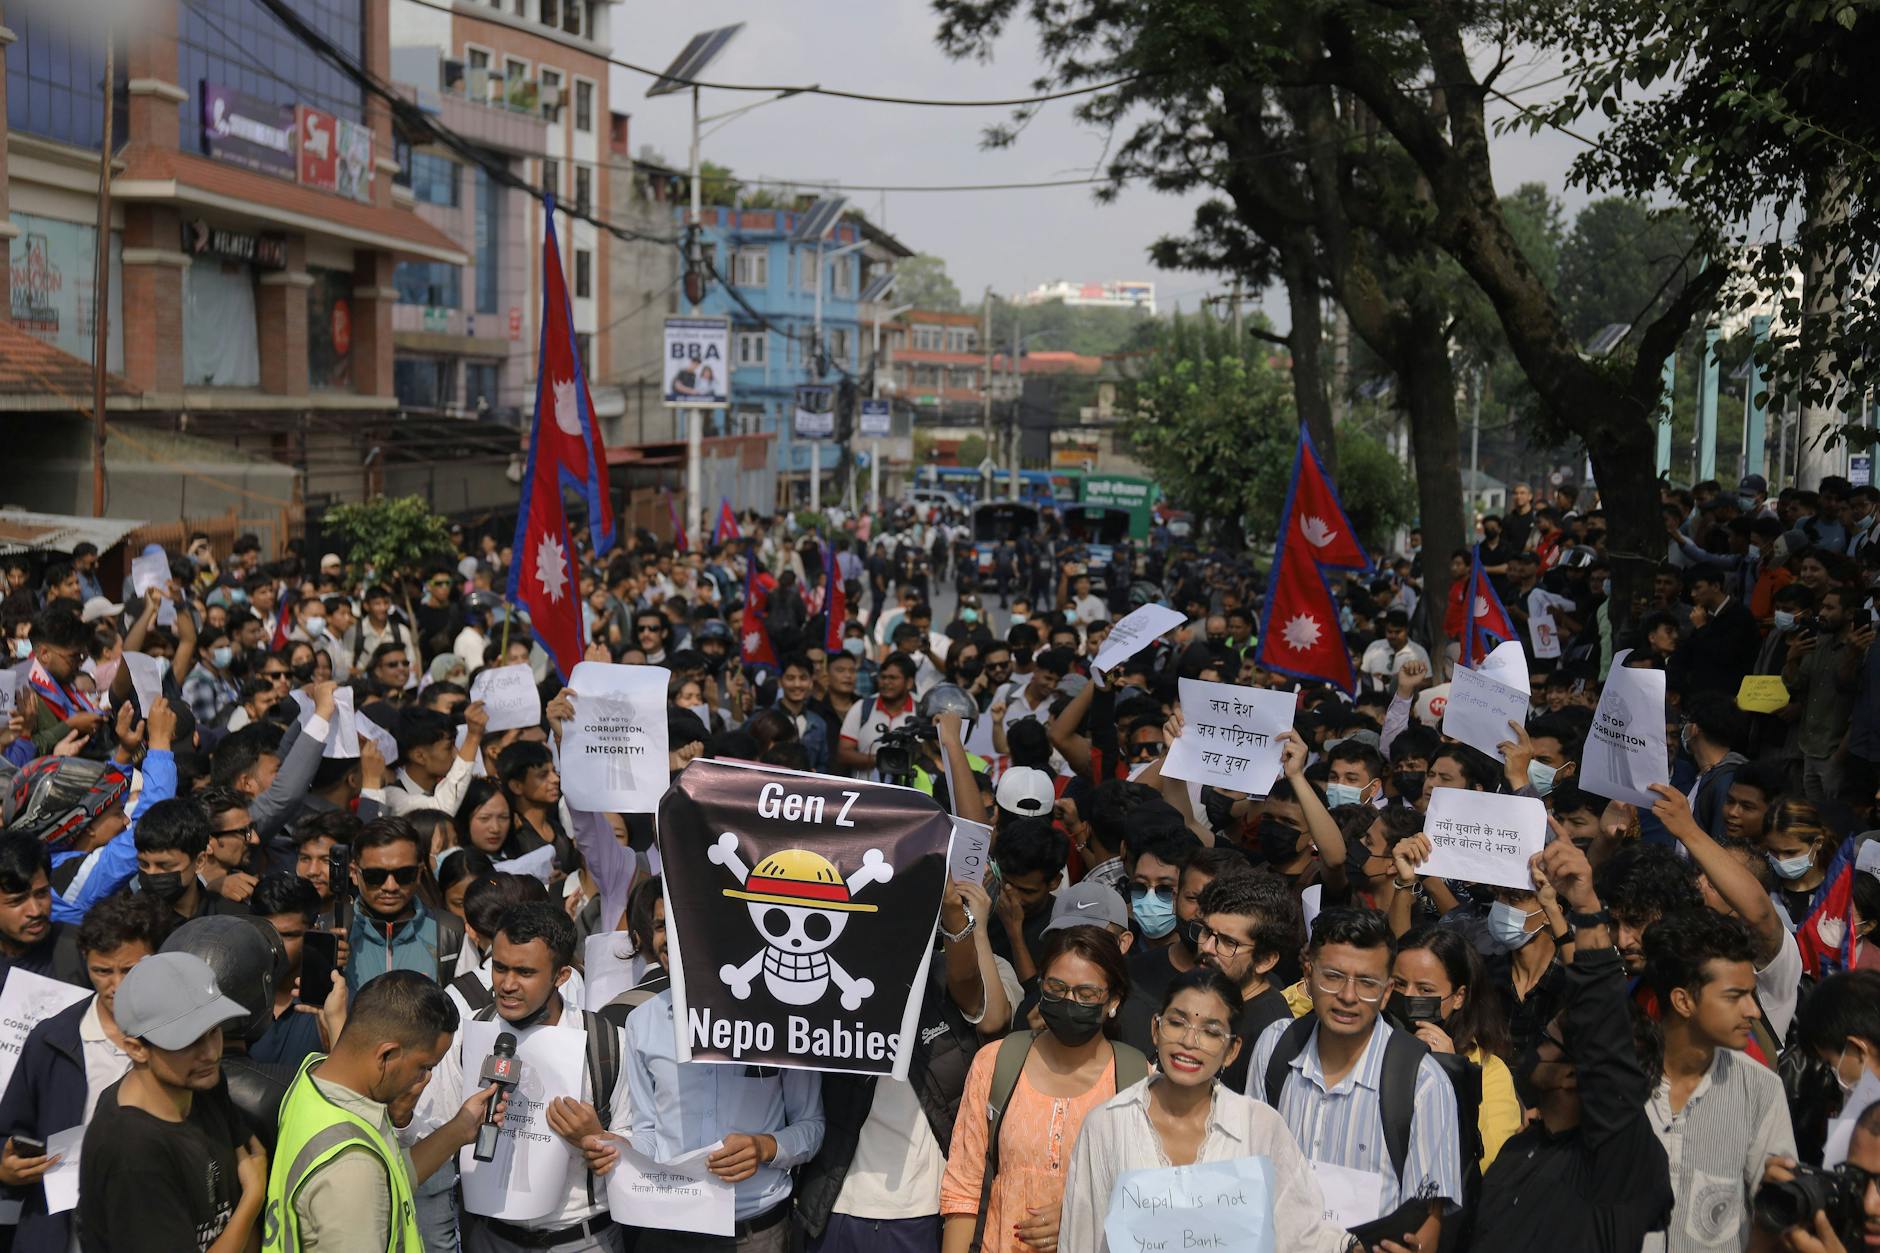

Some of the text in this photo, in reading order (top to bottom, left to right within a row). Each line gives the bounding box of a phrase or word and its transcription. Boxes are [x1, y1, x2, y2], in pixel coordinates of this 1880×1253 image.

[671, 343, 720, 360] BBA
[1209, 697, 1254, 718] जय देश
[584, 725, 645, 734] CORRUPTION,
[1602, 713, 1625, 728] STOP
[1197, 723, 1269, 748] जय राष्ट्रियता
[585, 745, 645, 755] INTEGRITY!
[1201, 750, 1223, 766] जय
[1225, 755, 1251, 774] युवा
[757, 782, 861, 827] Gen Z
[1455, 822, 1481, 836] युवाले
[1484, 823, 1494, 836] के
[1433, 834, 1456, 848] खुलेर
[1485, 839, 1493, 852] दे
[960, 836, 984, 881] NOW
[3, 1018, 32, 1033] CORR
[687, 1007, 904, 1063] Nepo Babies
[1121, 1185, 1247, 1216] Nepal is not
[1183, 1229, 1228, 1249] Bank
